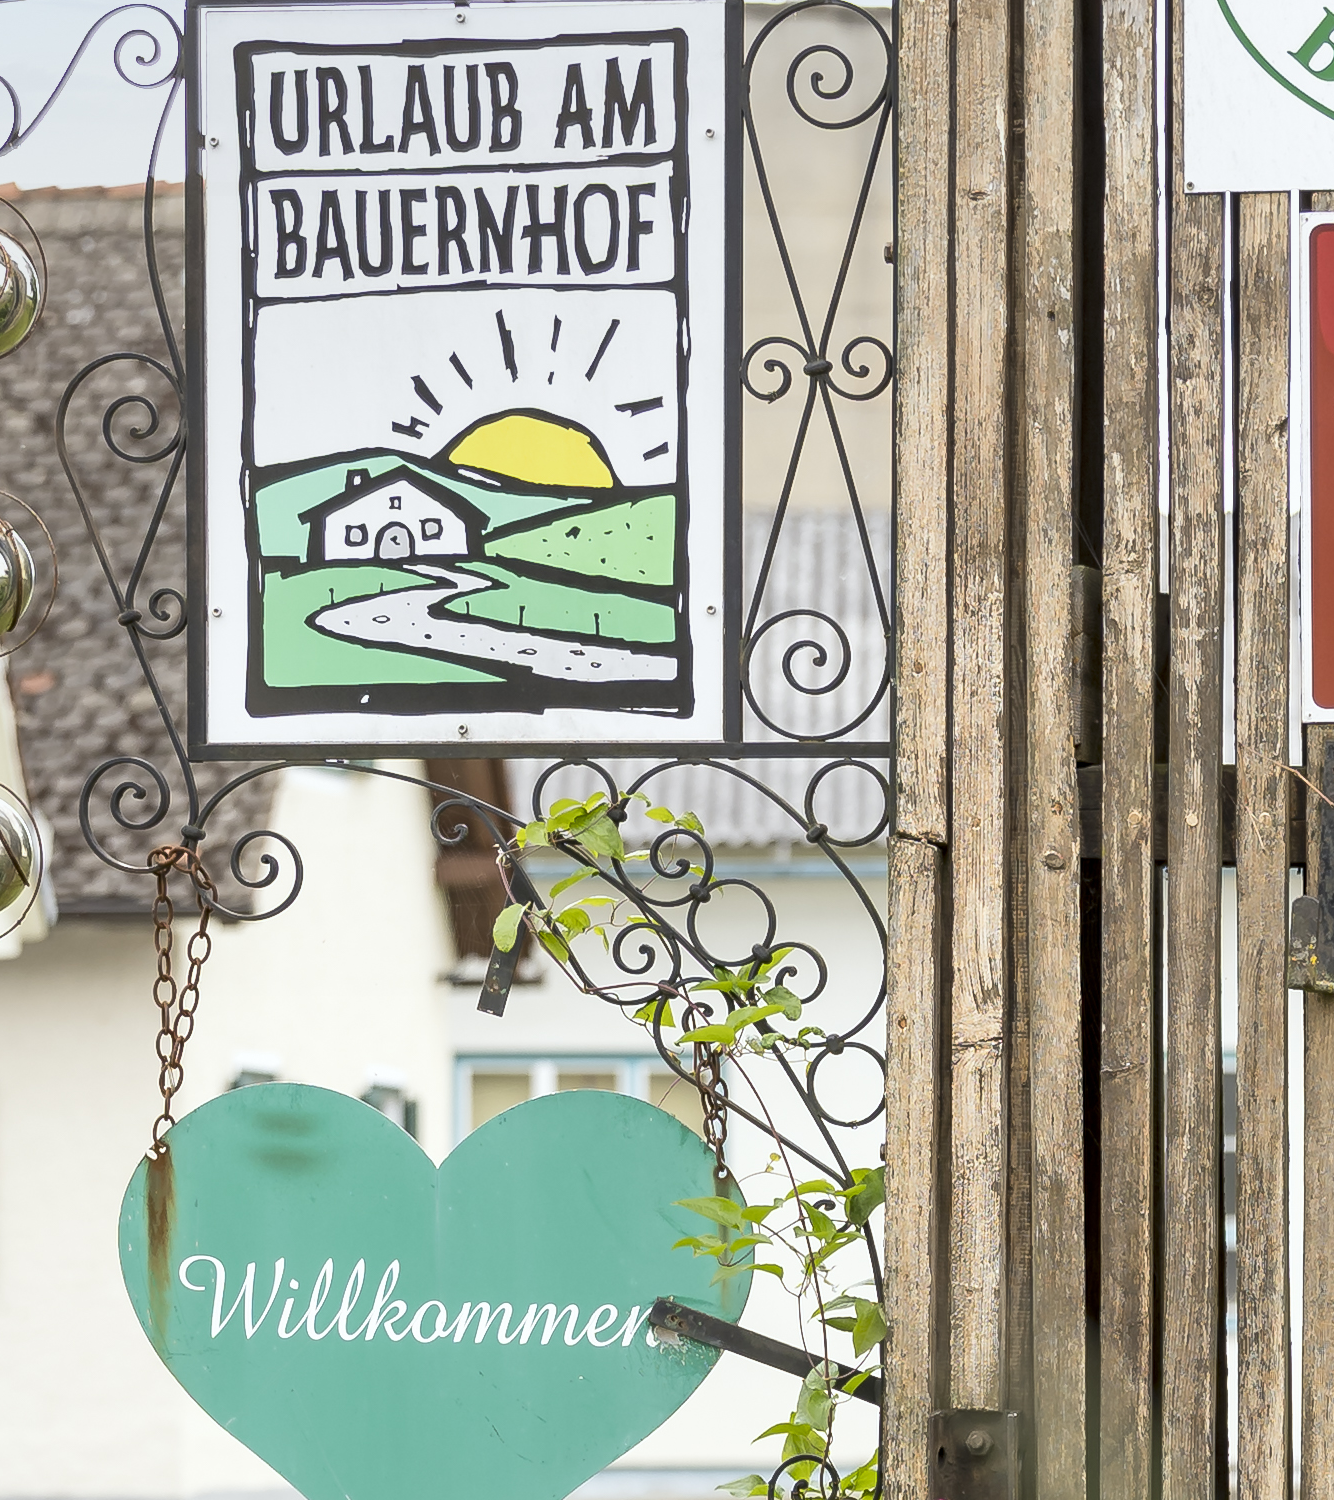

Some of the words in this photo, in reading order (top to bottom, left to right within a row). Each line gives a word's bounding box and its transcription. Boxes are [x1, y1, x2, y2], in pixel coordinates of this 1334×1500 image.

[268, 59, 524, 157] URLAUB
[555, 55, 658, 150] AM
[267, 182, 657, 282] BAUERNHOF
